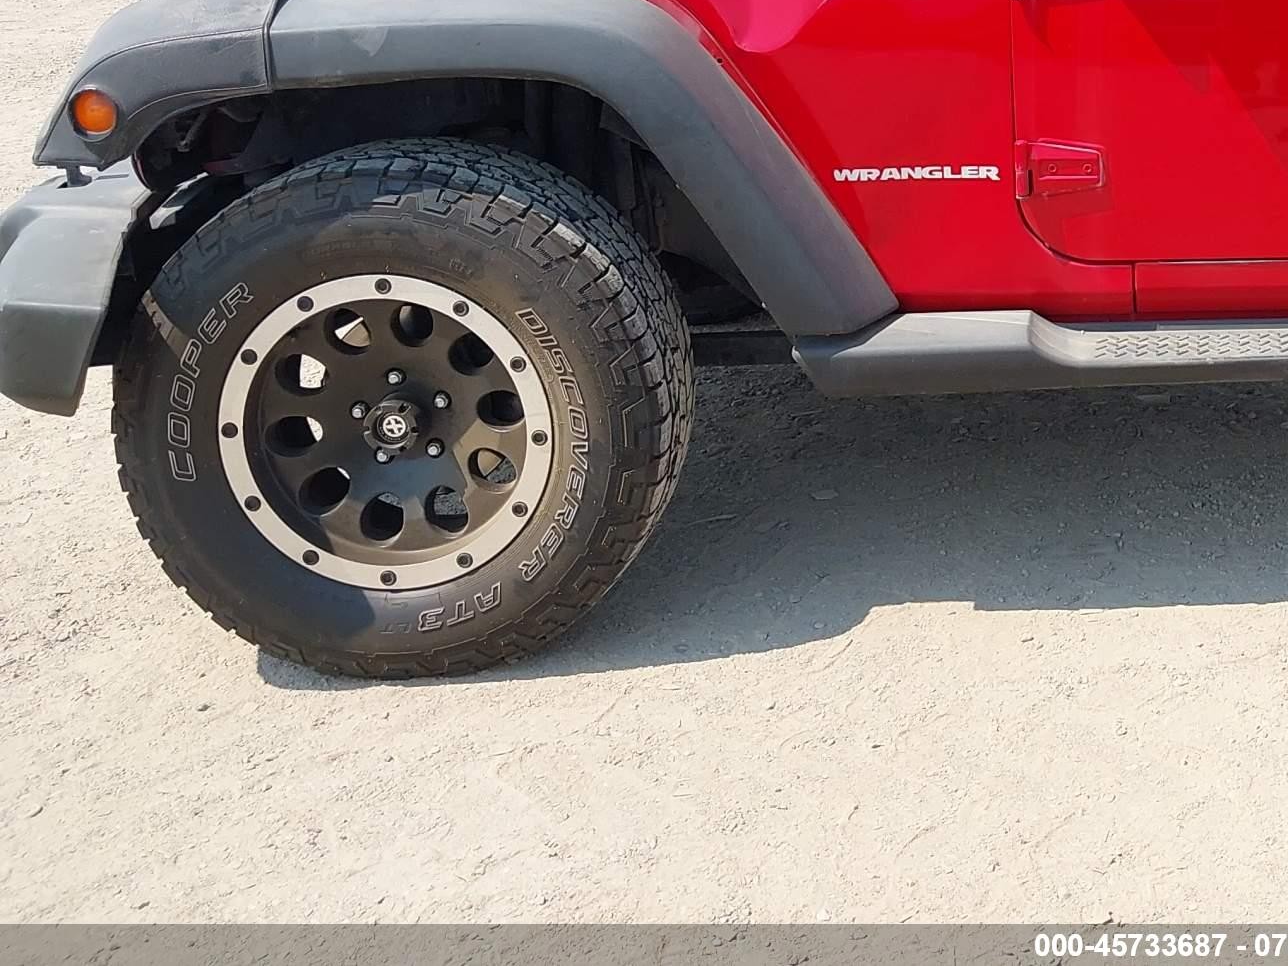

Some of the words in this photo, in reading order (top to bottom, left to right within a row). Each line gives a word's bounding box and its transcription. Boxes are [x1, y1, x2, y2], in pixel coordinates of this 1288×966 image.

[833, 165, 1001, 182] WRANGLER
[167, 281, 255, 483] COOPER
[515, 307, 591, 582] DISCOVERER
[417, 581, 502, 632] AT3
